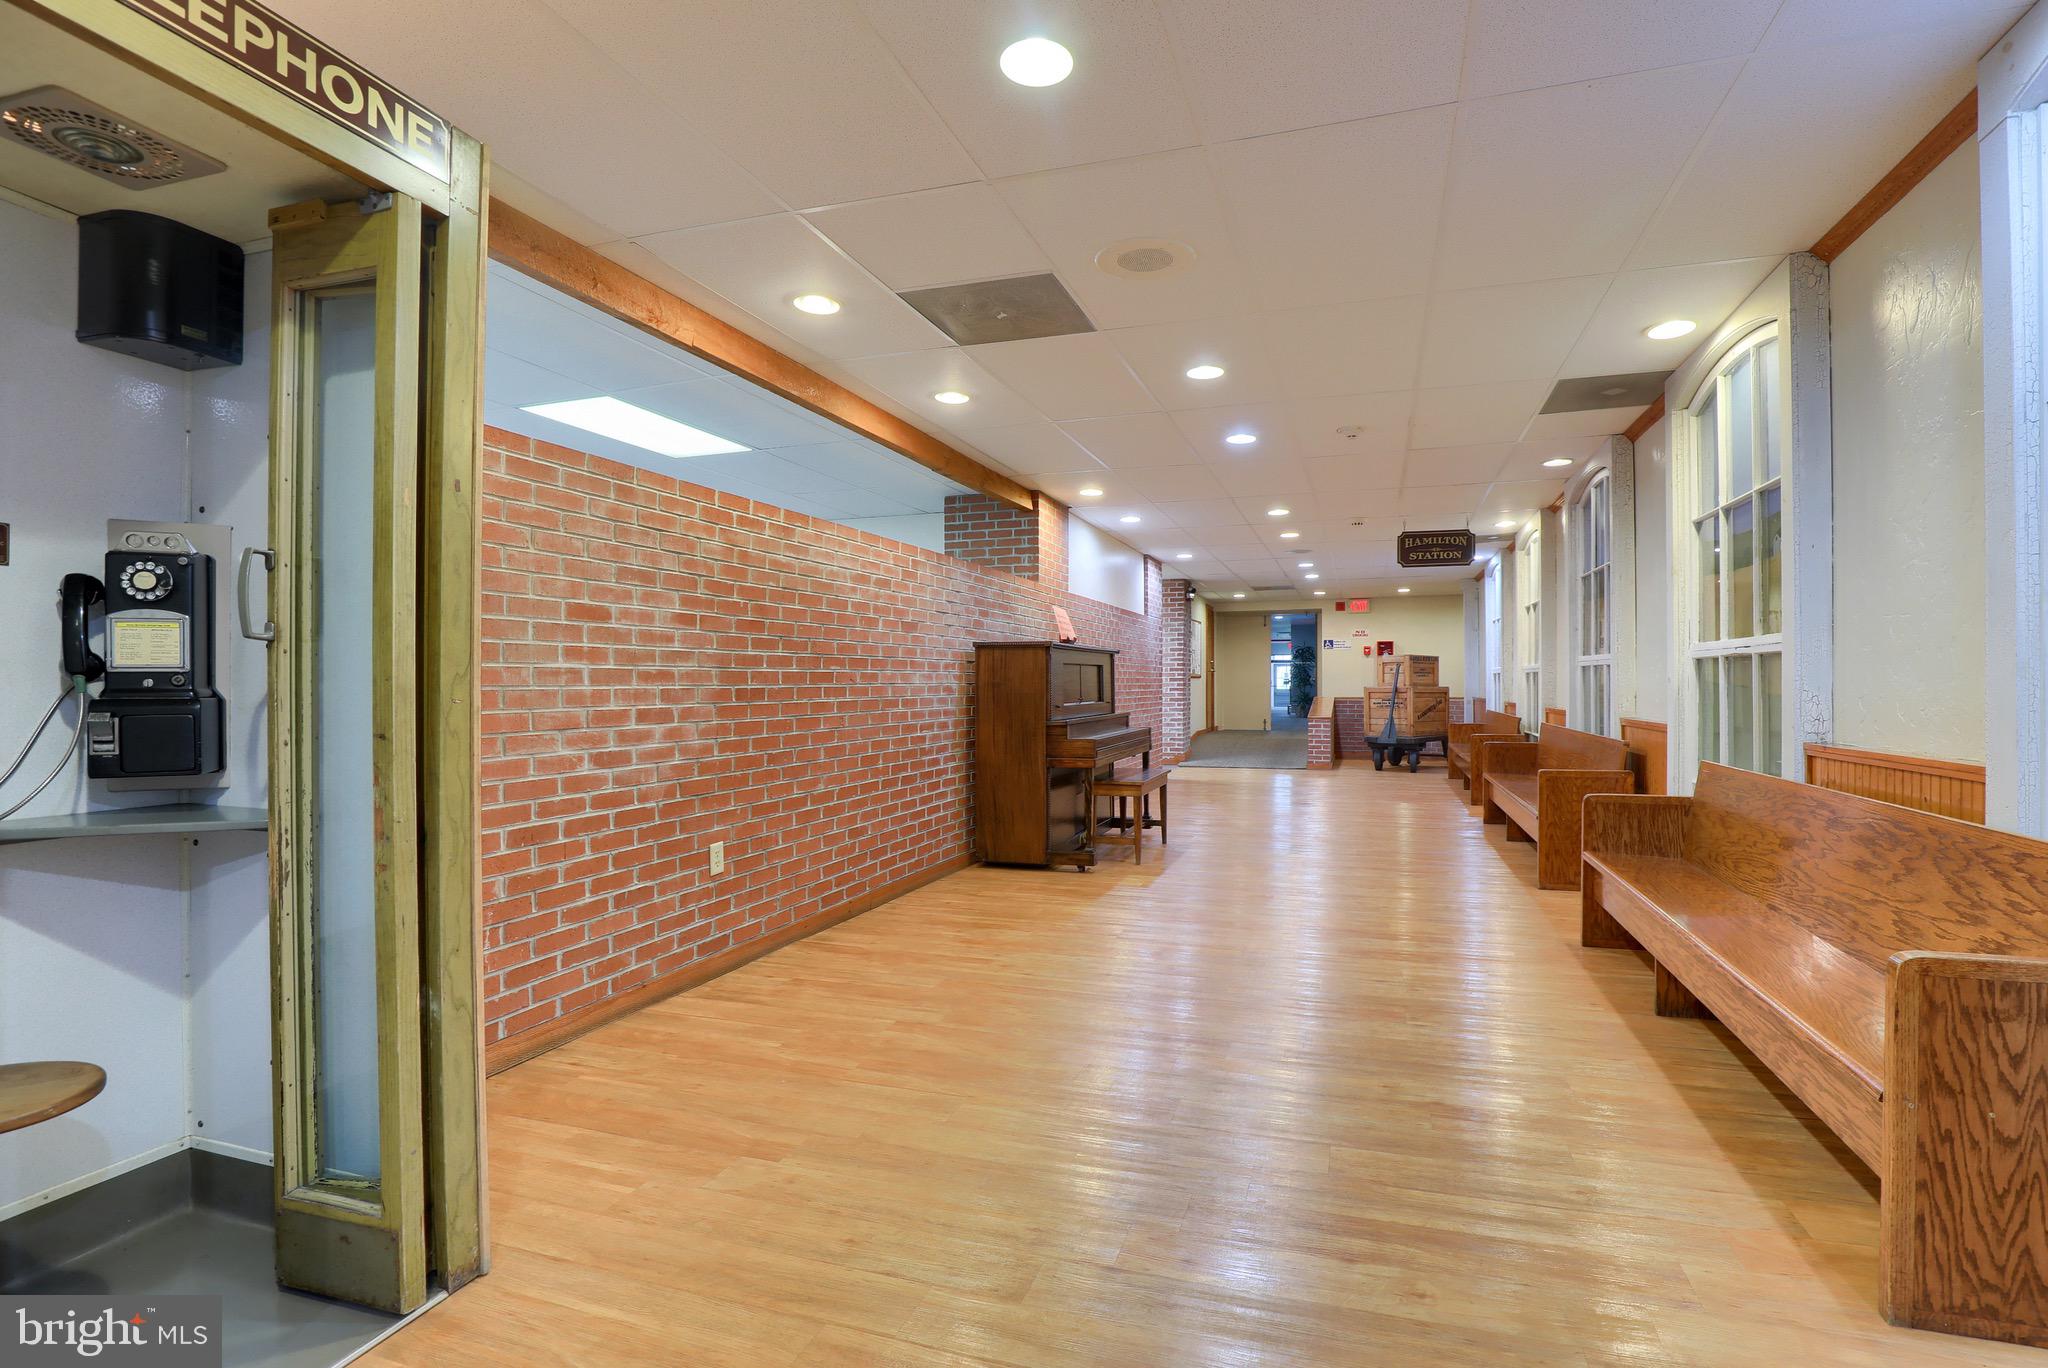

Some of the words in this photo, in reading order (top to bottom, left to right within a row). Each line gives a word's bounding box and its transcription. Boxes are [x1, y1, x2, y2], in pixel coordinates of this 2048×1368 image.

[149, 0, 434, 158] EPHONE
[1405, 536, 1468, 548] HAMILTON
[1409, 551, 1462, 560] STATION
